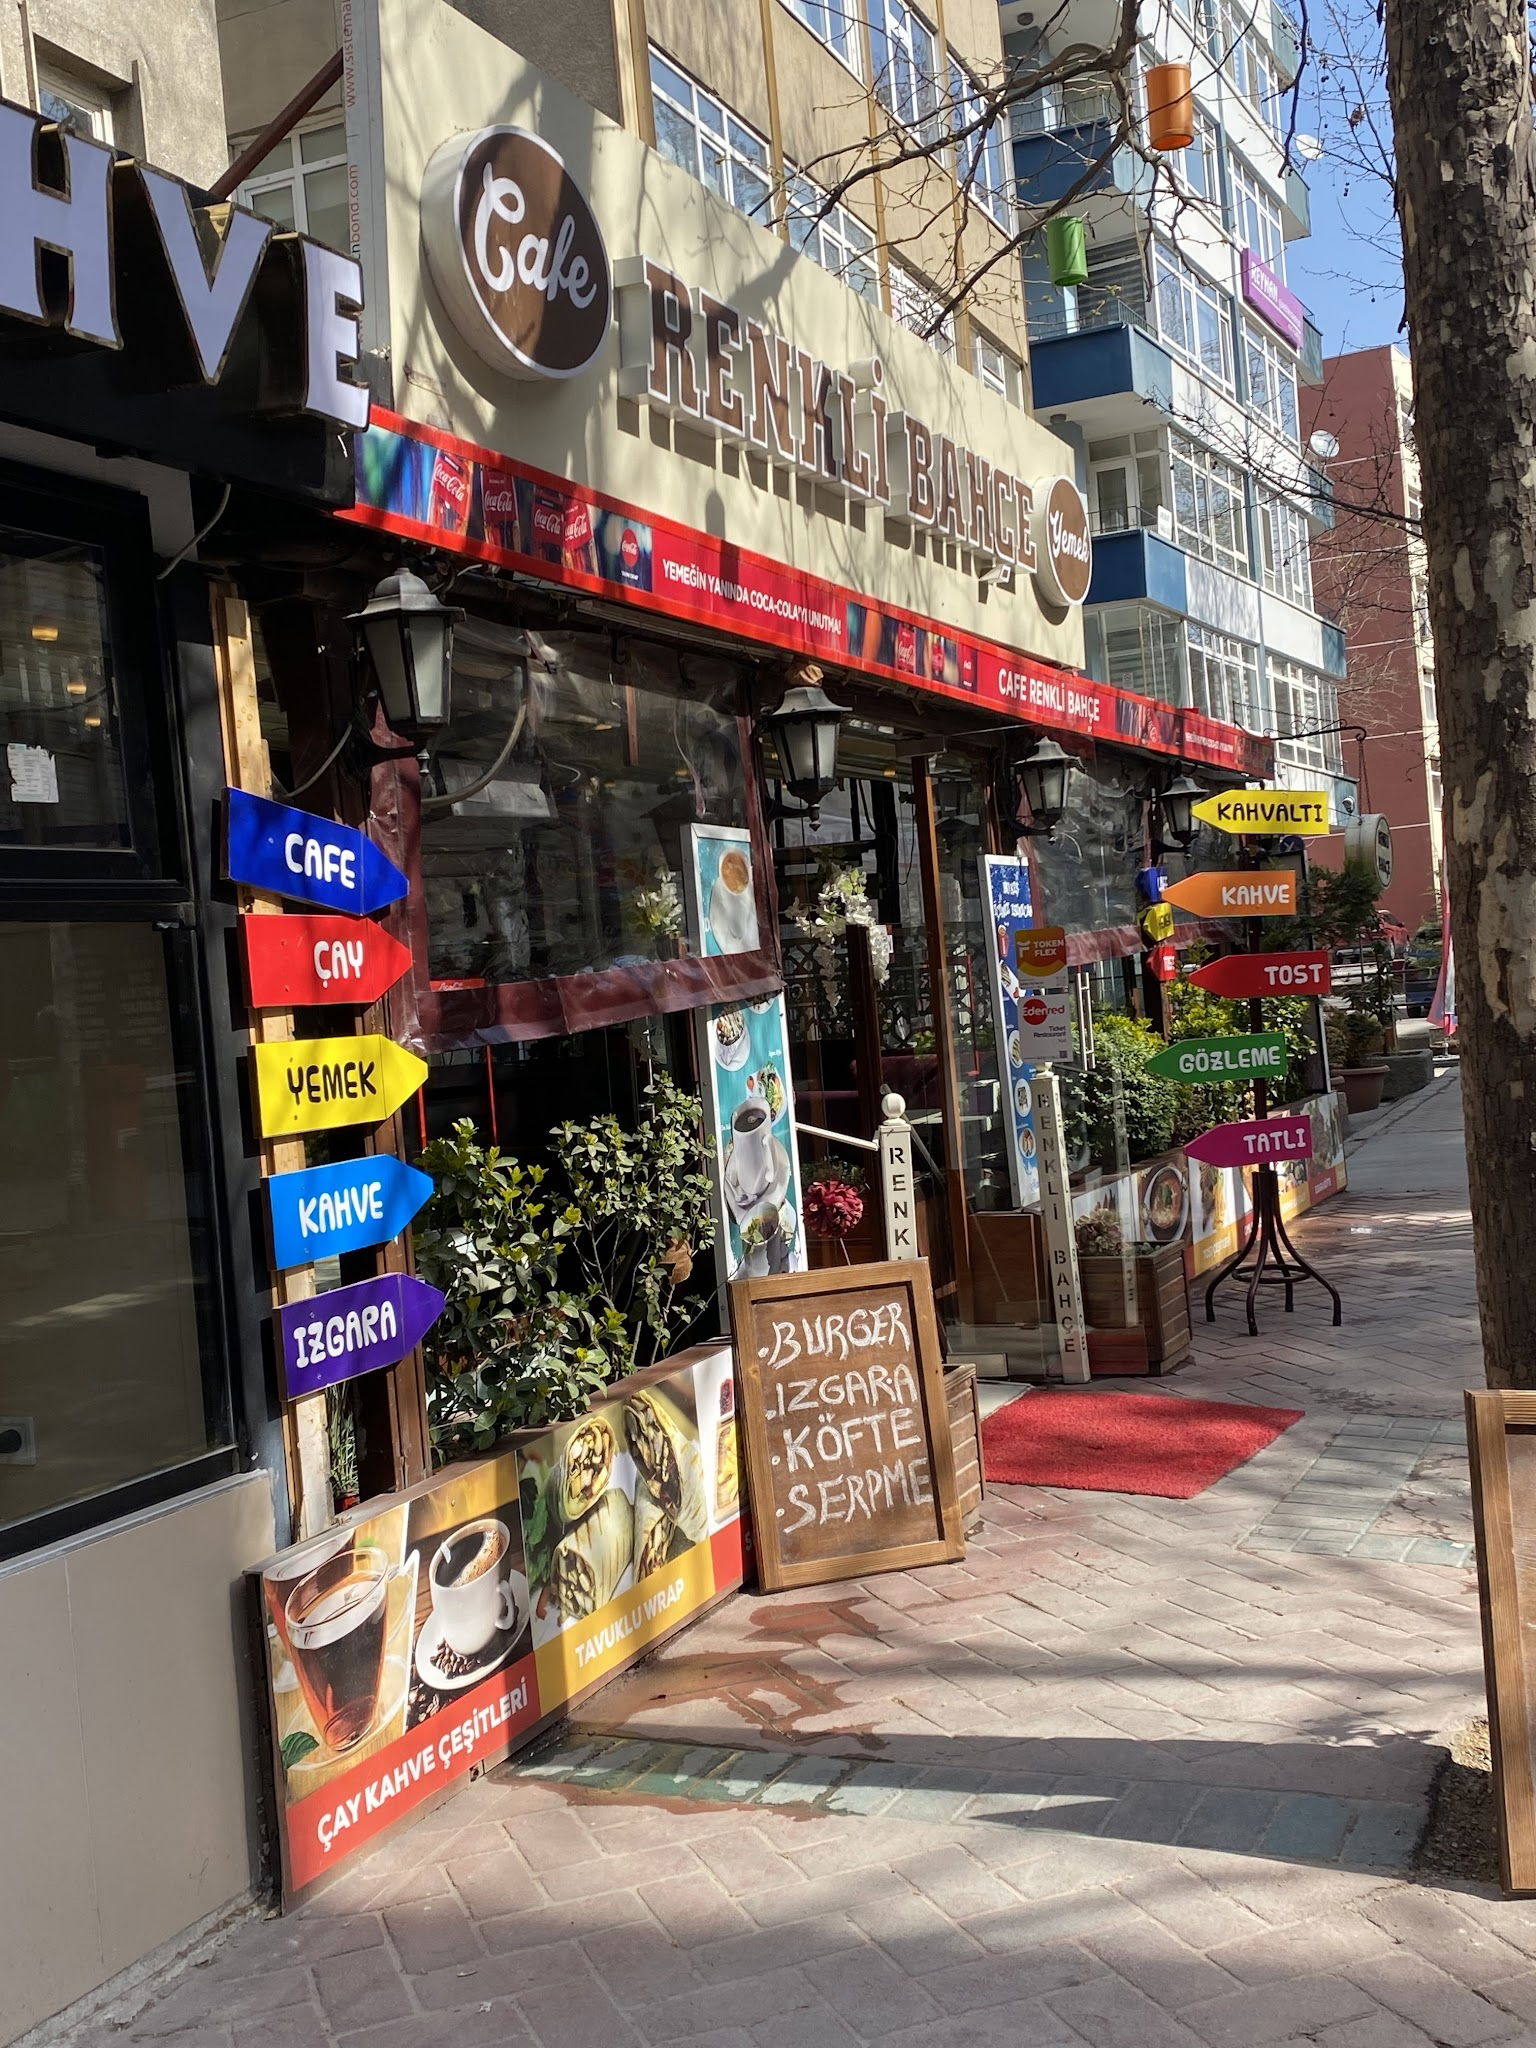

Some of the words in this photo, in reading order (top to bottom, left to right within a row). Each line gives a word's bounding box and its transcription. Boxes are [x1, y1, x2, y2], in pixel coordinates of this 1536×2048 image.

[474, 162, 597, 309] Cafe
[642, 254, 891, 506] RENKLİ
[902, 409, 1038, 584] BAHÇE
[1049, 509, 1090, 564] Yemek
[661, 558, 707, 592] YEMEĞİN
[708, 574, 750, 605] YANINDA
[809, 610, 842, 635] UNUTMA!
[998, 667, 1027, 701] CAFE
[1029, 680, 1066, 713] RENKLİ
[1067, 690, 1100, 724] BAHÇE
[1217, 802, 1324, 823] KAHVALTI
[284, 833, 357, 889] CAFE
[1221, 884, 1291, 906] KAHVE
[313, 940, 364, 989] ÇAY
[1033, 940, 1065, 949] TOKEN
[1034, 948, 1057, 957] FLEX
[1264, 963, 1324, 986] TOST
[1023, 1004, 1065, 1017] Edenred
[287, 1061, 378, 1106] YEMEK
[1178, 1045, 1281, 1073] GÖZLEME
[1242, 1127, 1306, 1154] TATLI
[298, 1181, 384, 1238] KAHVE
[889, 1147, 911, 1260] RENK
[293, 1300, 397, 1369] IZGARA
[575, 1611, 642, 1669] TAVUKLU
[643, 1577, 685, 1624] WRAP
[317, 1794, 360, 1852] ÇAY
[364, 1744, 436, 1812] KAHVE
[438, 1676, 529, 1770] ÇEŞİTLERİ
